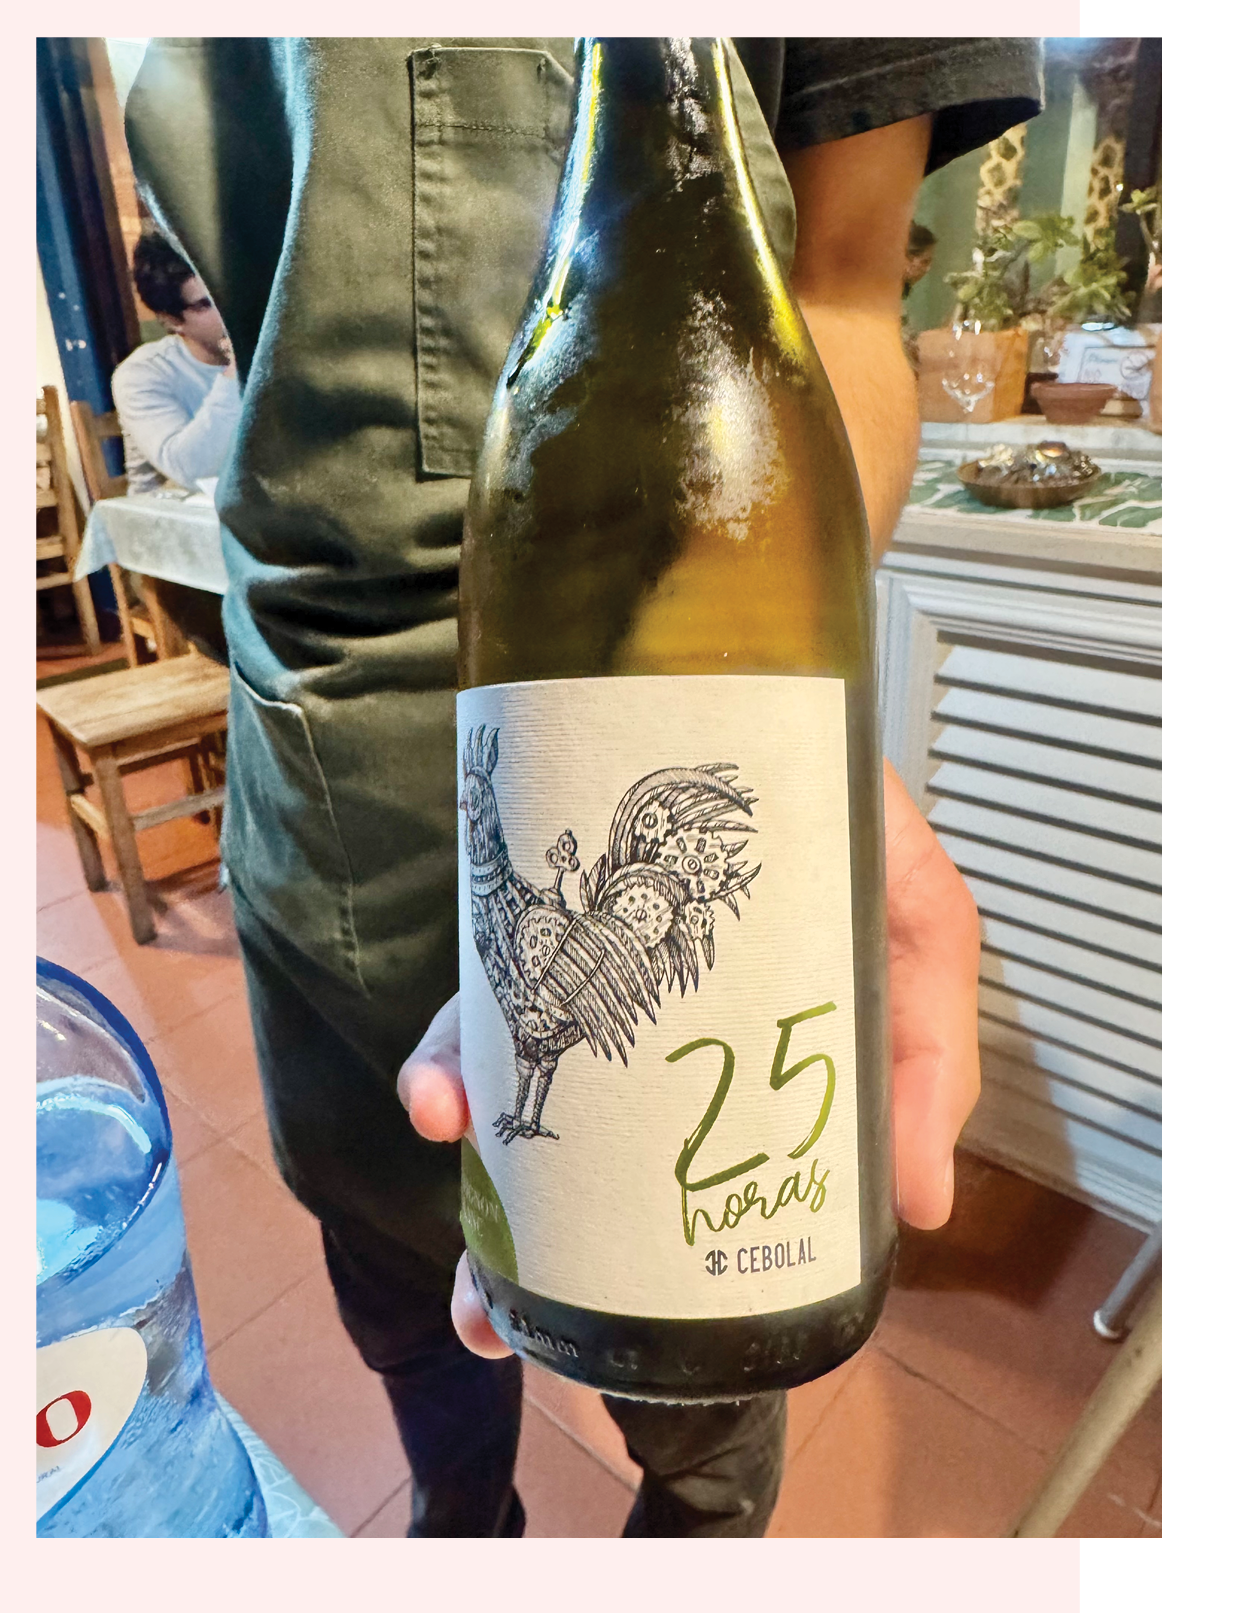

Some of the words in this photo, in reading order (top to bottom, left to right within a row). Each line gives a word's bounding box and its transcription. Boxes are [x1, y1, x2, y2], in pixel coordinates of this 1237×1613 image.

[665, 1001, 837, 1192] 25
[681, 1158, 830, 1246] horas
[737, 1236, 817, 1275] CEBOLAL
